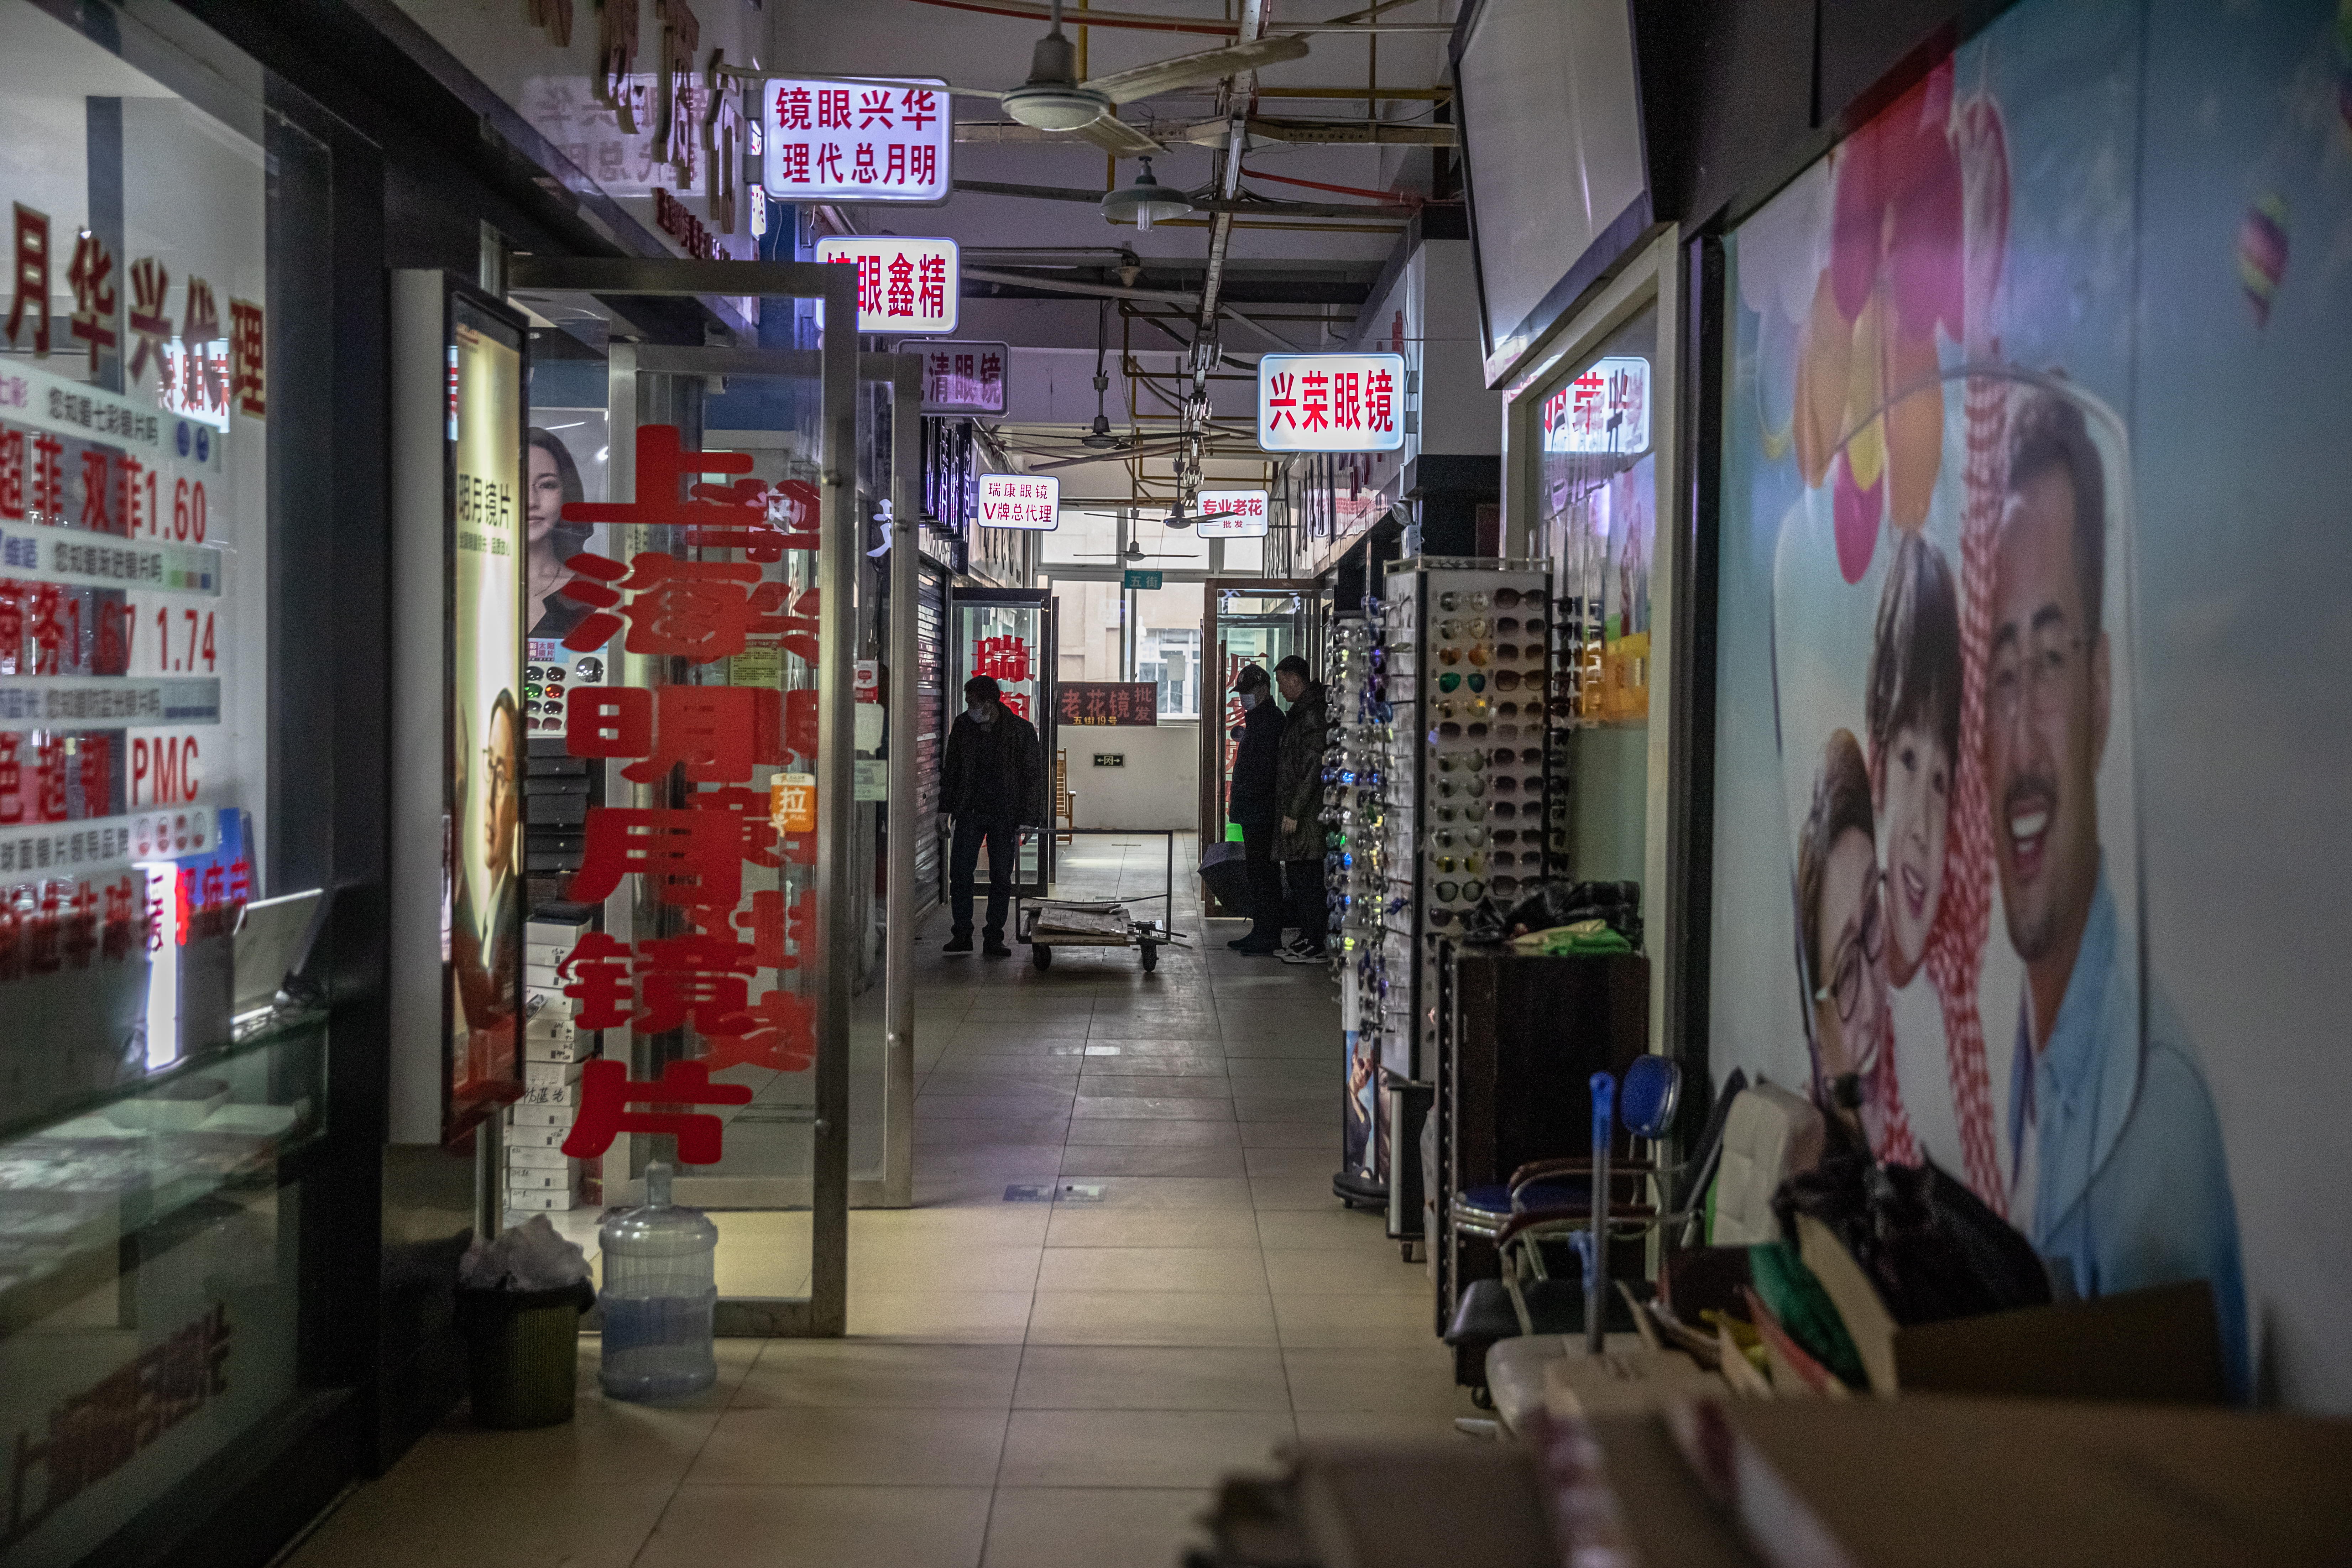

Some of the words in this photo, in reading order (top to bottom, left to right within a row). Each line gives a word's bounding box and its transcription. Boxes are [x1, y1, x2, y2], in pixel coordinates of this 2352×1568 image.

[776, 87, 936, 131] 镜眼兴华
[783, 142, 936, 185] 理代总月明
[827, 252, 946, 318] 眼鑫精
[921, 352, 1002, 404] 清眼镜
[1270, 369, 1393, 433] 兴荣眼镜
[459, 474, 511, 529] 明月镜片
[983, 502, 1052, 523] V牌总代理
[988, 482, 1048, 500] 瑞康眼镜
[1203, 498, 1263, 517] 专业老花
[1223, 520, 1243, 529] 批发
[1130, 576, 1157, 588] 五街
[157, 607, 216, 671] 1.74
[1062, 689, 1130, 718] 老花镜
[1134, 687, 1152, 721] 批发
[1073, 716, 1117, 725] 五街19号
[132, 735, 199, 805] PMC
[557, 425, 767, 1164] 上海明月镜片
[779, 786, 806, 813] 拉
